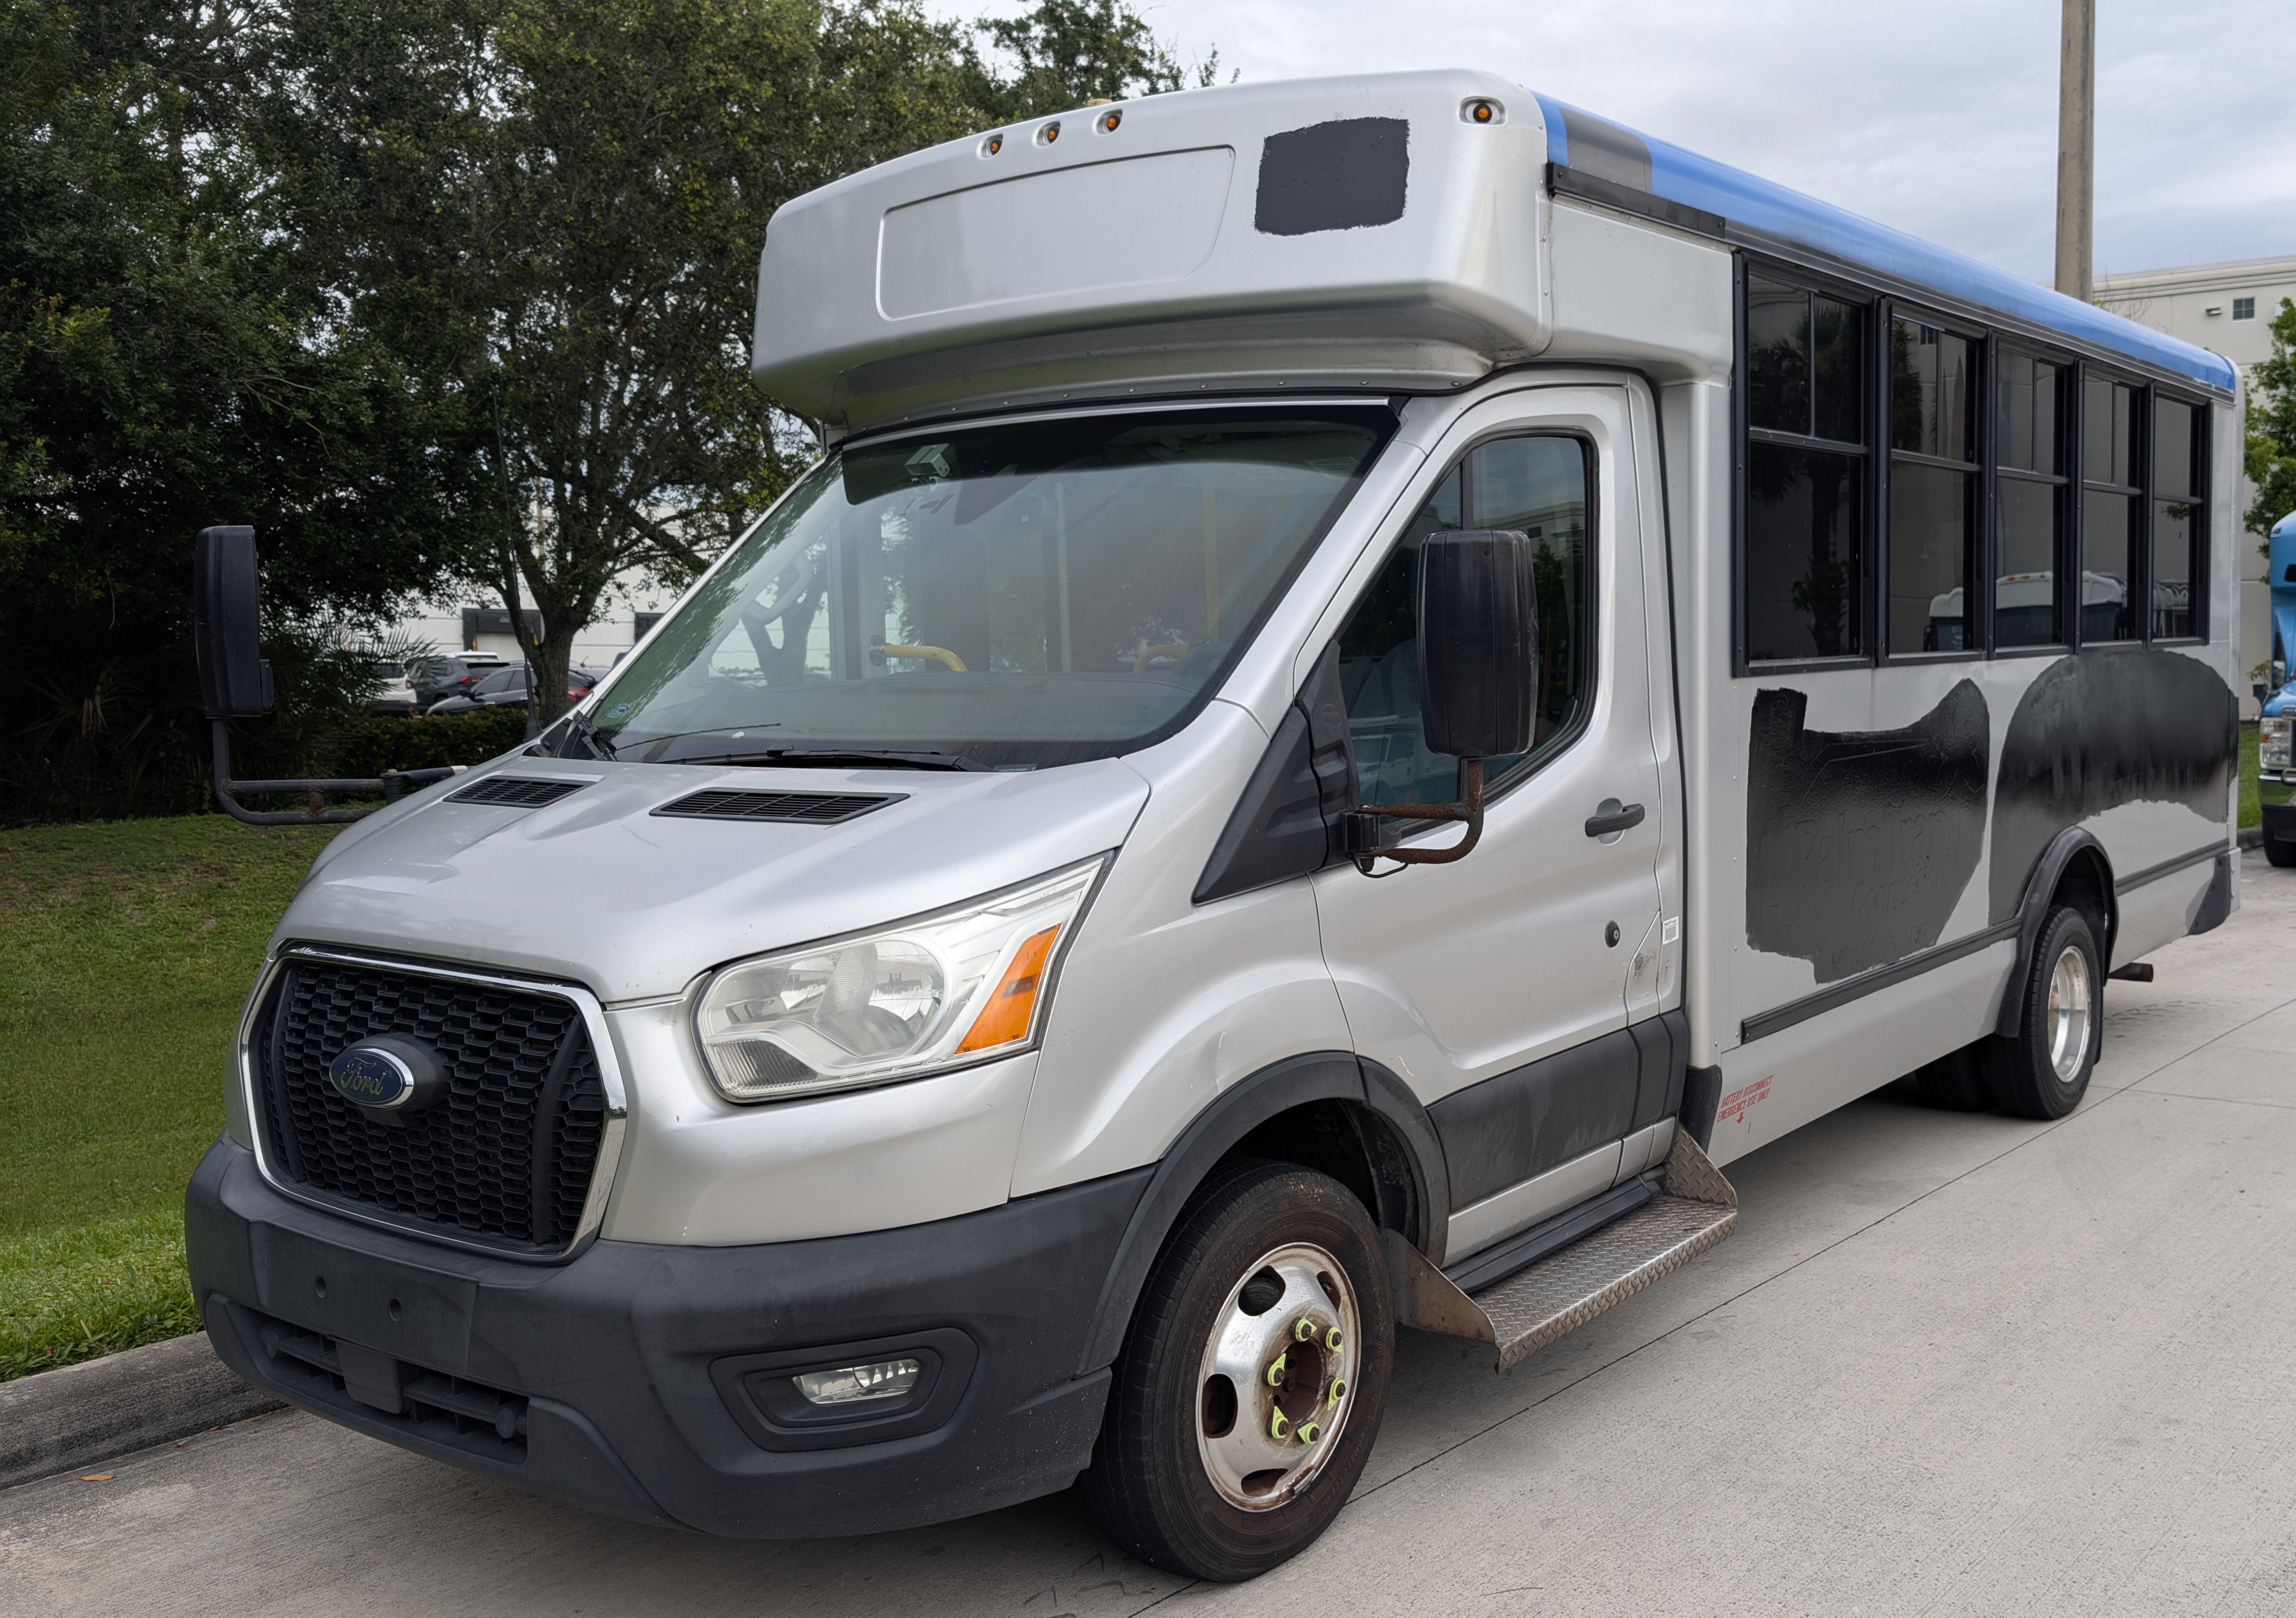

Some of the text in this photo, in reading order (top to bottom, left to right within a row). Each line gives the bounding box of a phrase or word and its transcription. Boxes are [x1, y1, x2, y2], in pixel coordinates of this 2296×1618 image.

[340, 1057, 388, 1096] Ford
[1721, 1074, 1774, 1109] BATTERY DISCONNECT
[1717, 1087, 1770, 1123] EMERGENCY USE ONLY
[1330, 1424, 1369, 1497] TRANSFORCE
